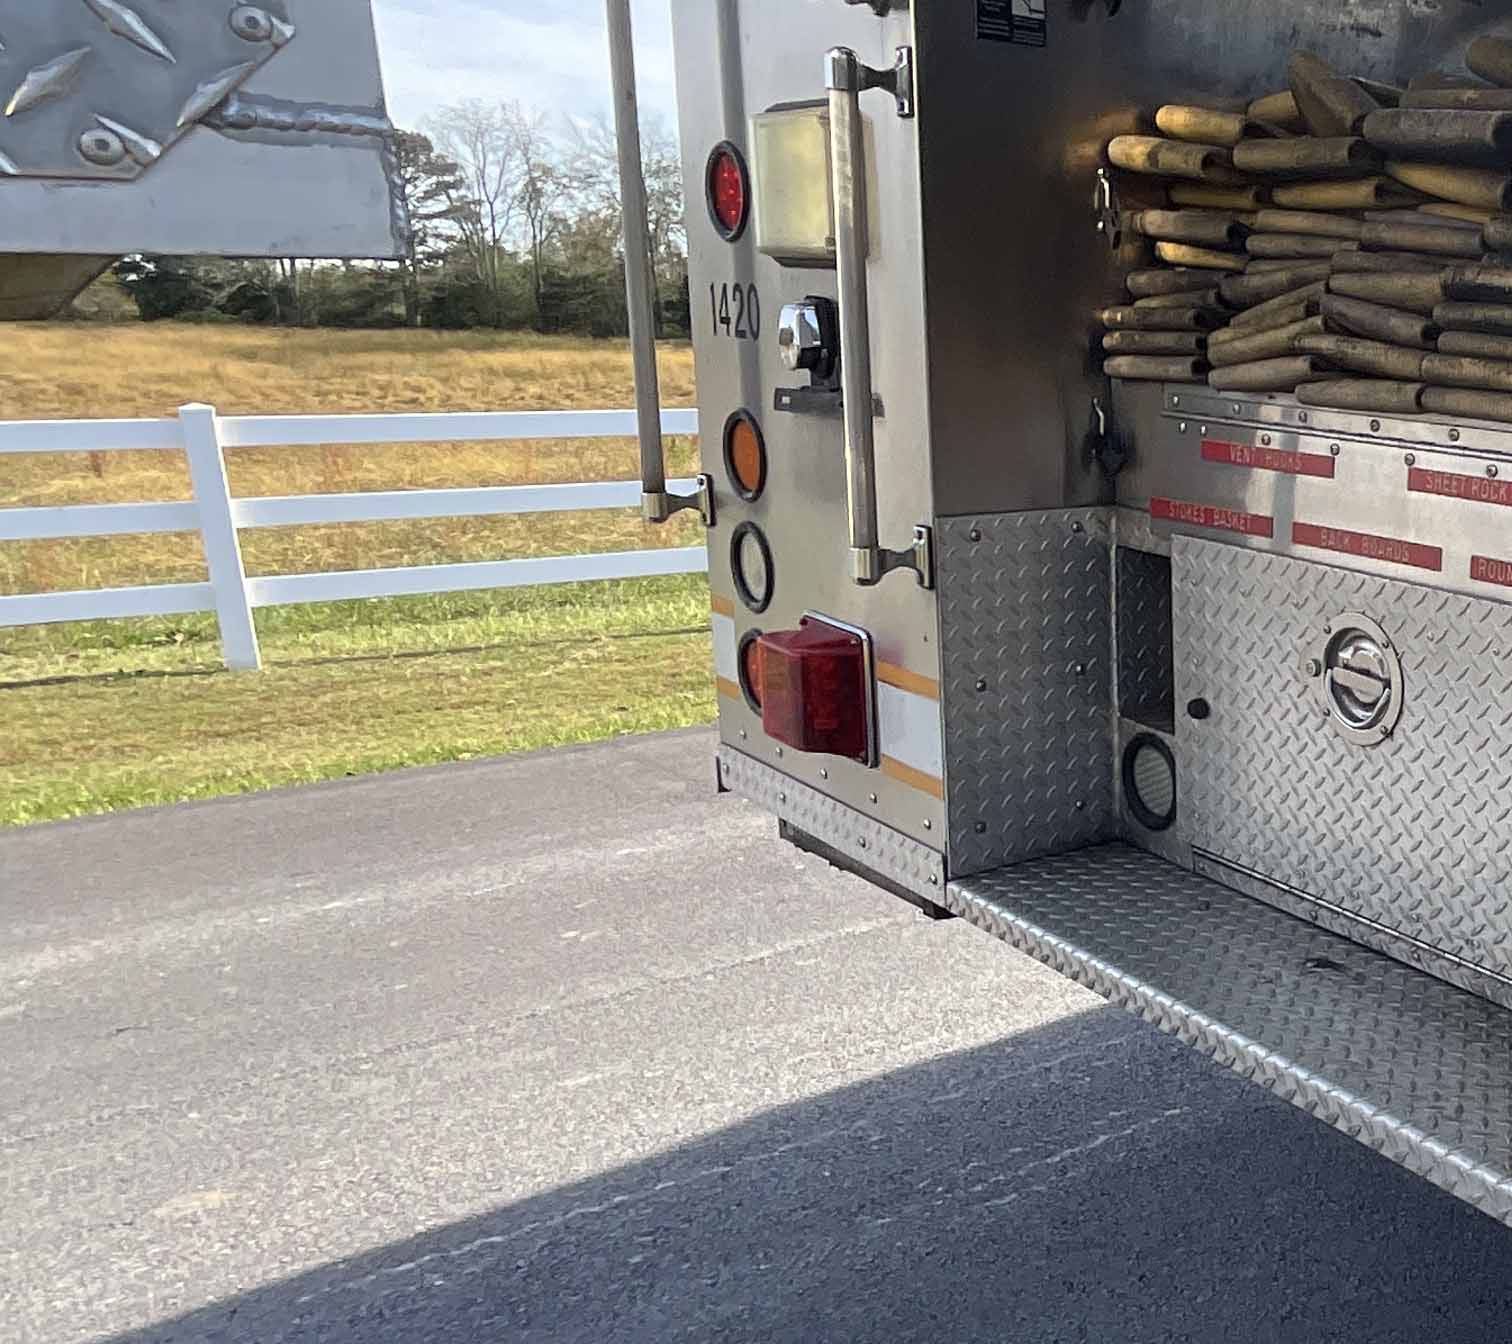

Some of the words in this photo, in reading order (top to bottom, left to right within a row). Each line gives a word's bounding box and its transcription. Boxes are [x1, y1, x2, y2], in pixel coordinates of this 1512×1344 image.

[710, 282, 761, 341] 1420
[1229, 444, 1257, 465] VENT
[1424, 473, 1466, 496] SHEET
[1471, 479, 1507, 501] ROCK
[1168, 501, 1206, 525] STOKES
[1213, 507, 1252, 532] BASKET
[1320, 528, 1353, 551] BACK
[1361, 536, 1410, 563] BOARDS
